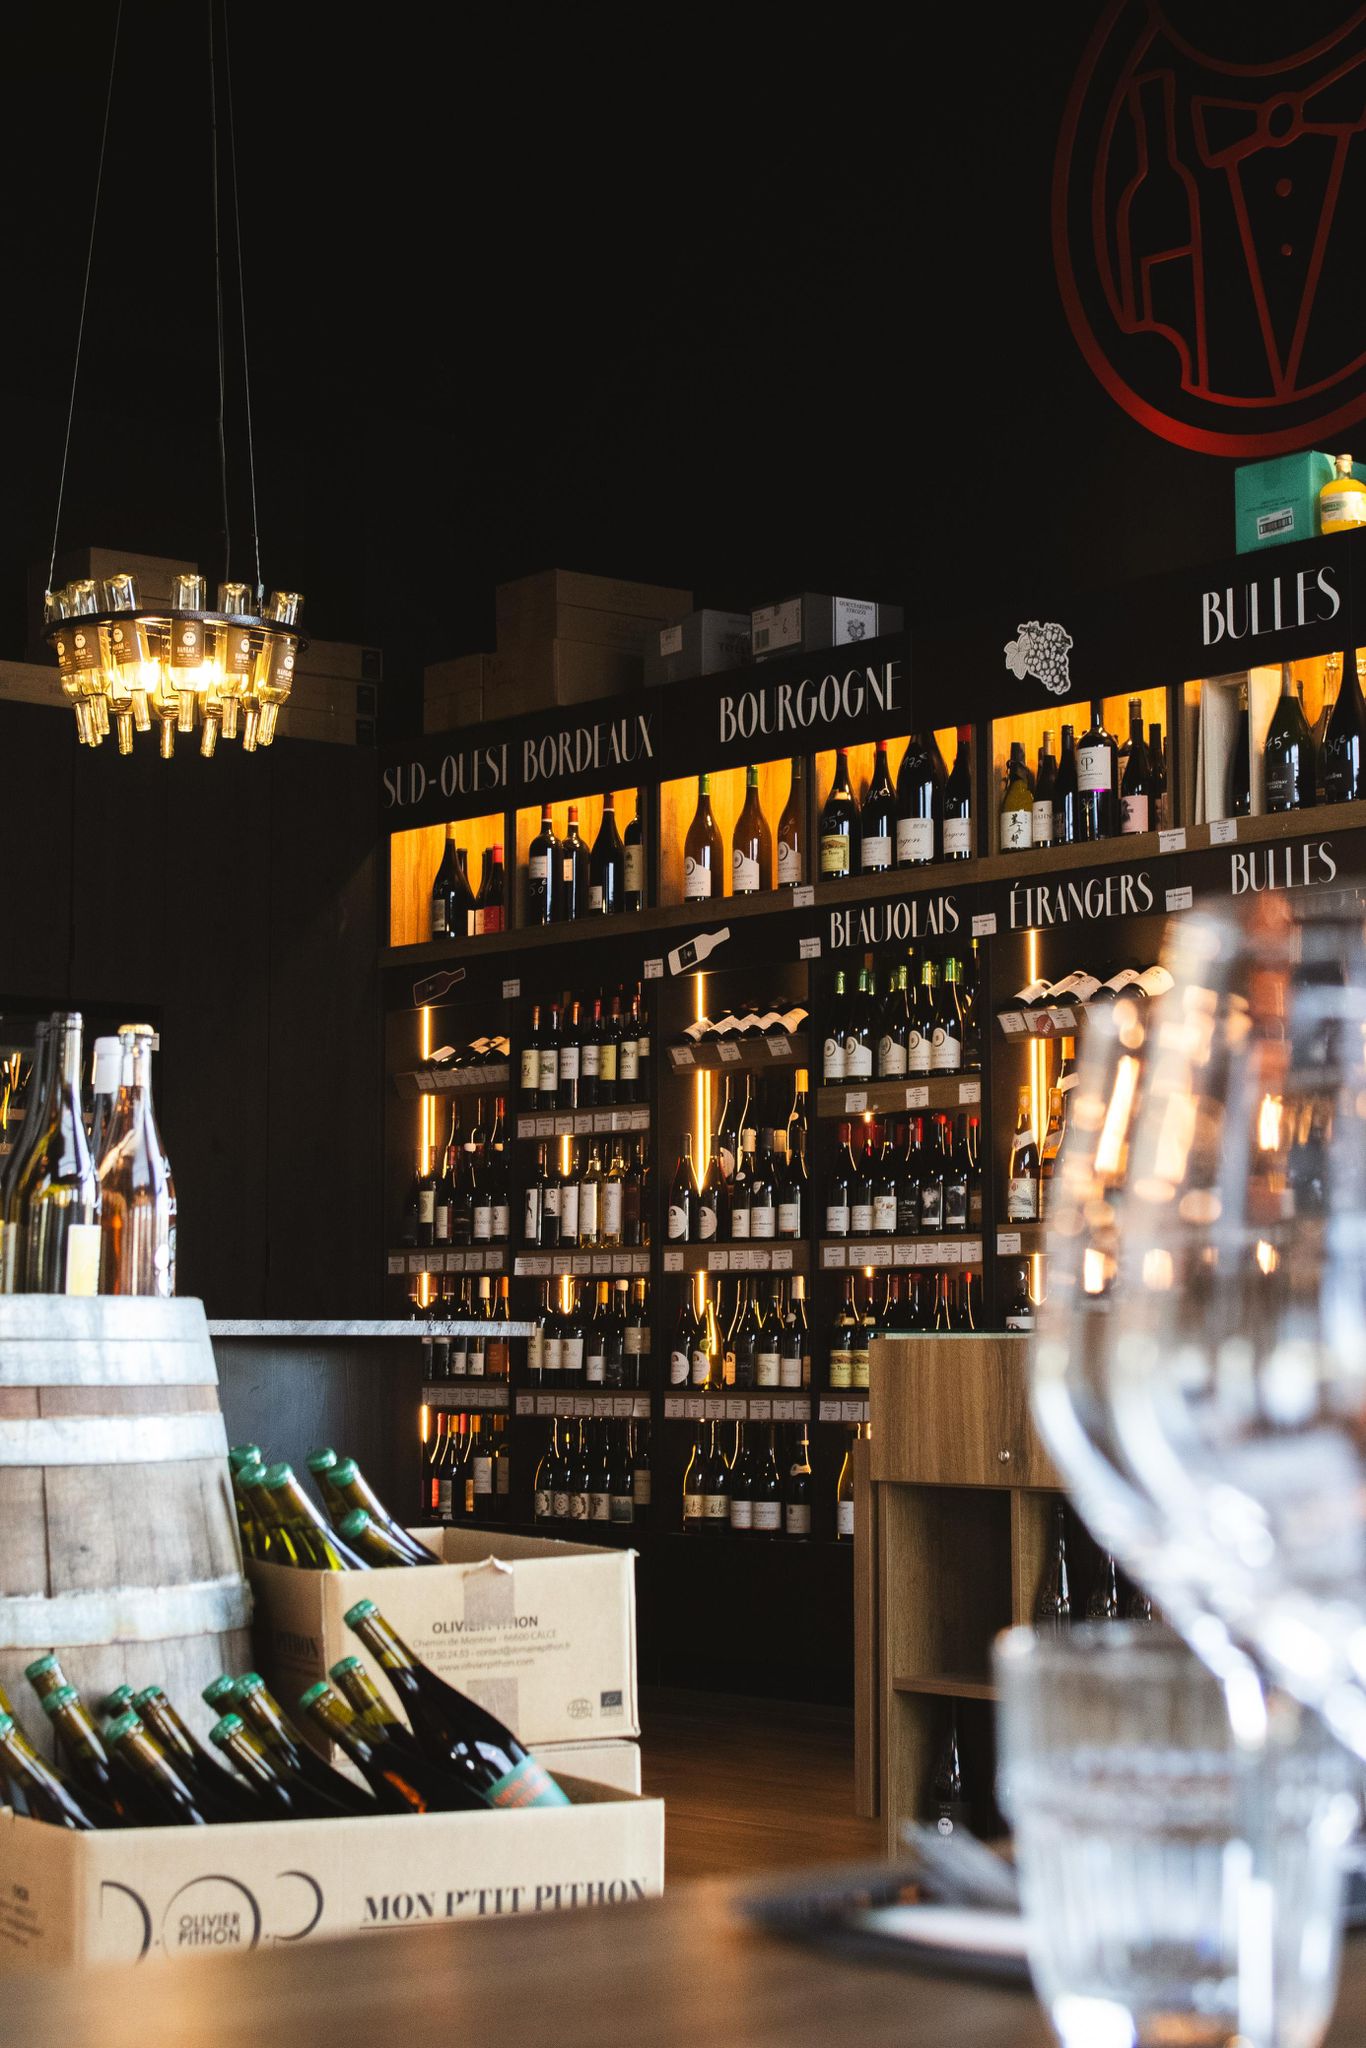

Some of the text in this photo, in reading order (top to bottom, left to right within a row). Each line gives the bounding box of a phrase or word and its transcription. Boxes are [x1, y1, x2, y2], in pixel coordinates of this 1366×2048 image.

[1202, 566, 1341, 646] BULLES
[719, 660, 903, 743] BOURGOGNE
[383, 713, 654, 809] SUD-OUEST BORDEAUX
[1231, 841, 1337, 896] BULLES
[830, 896, 959, 949] BEAUJOLAIS
[1010, 872, 1154, 929] ÉTRANGERS
[179, 1911, 241, 1930] OLIVIER
[365, 1878, 648, 1921] MON P'TIT PITHON
[178, 1926, 241, 1946] PITHON
